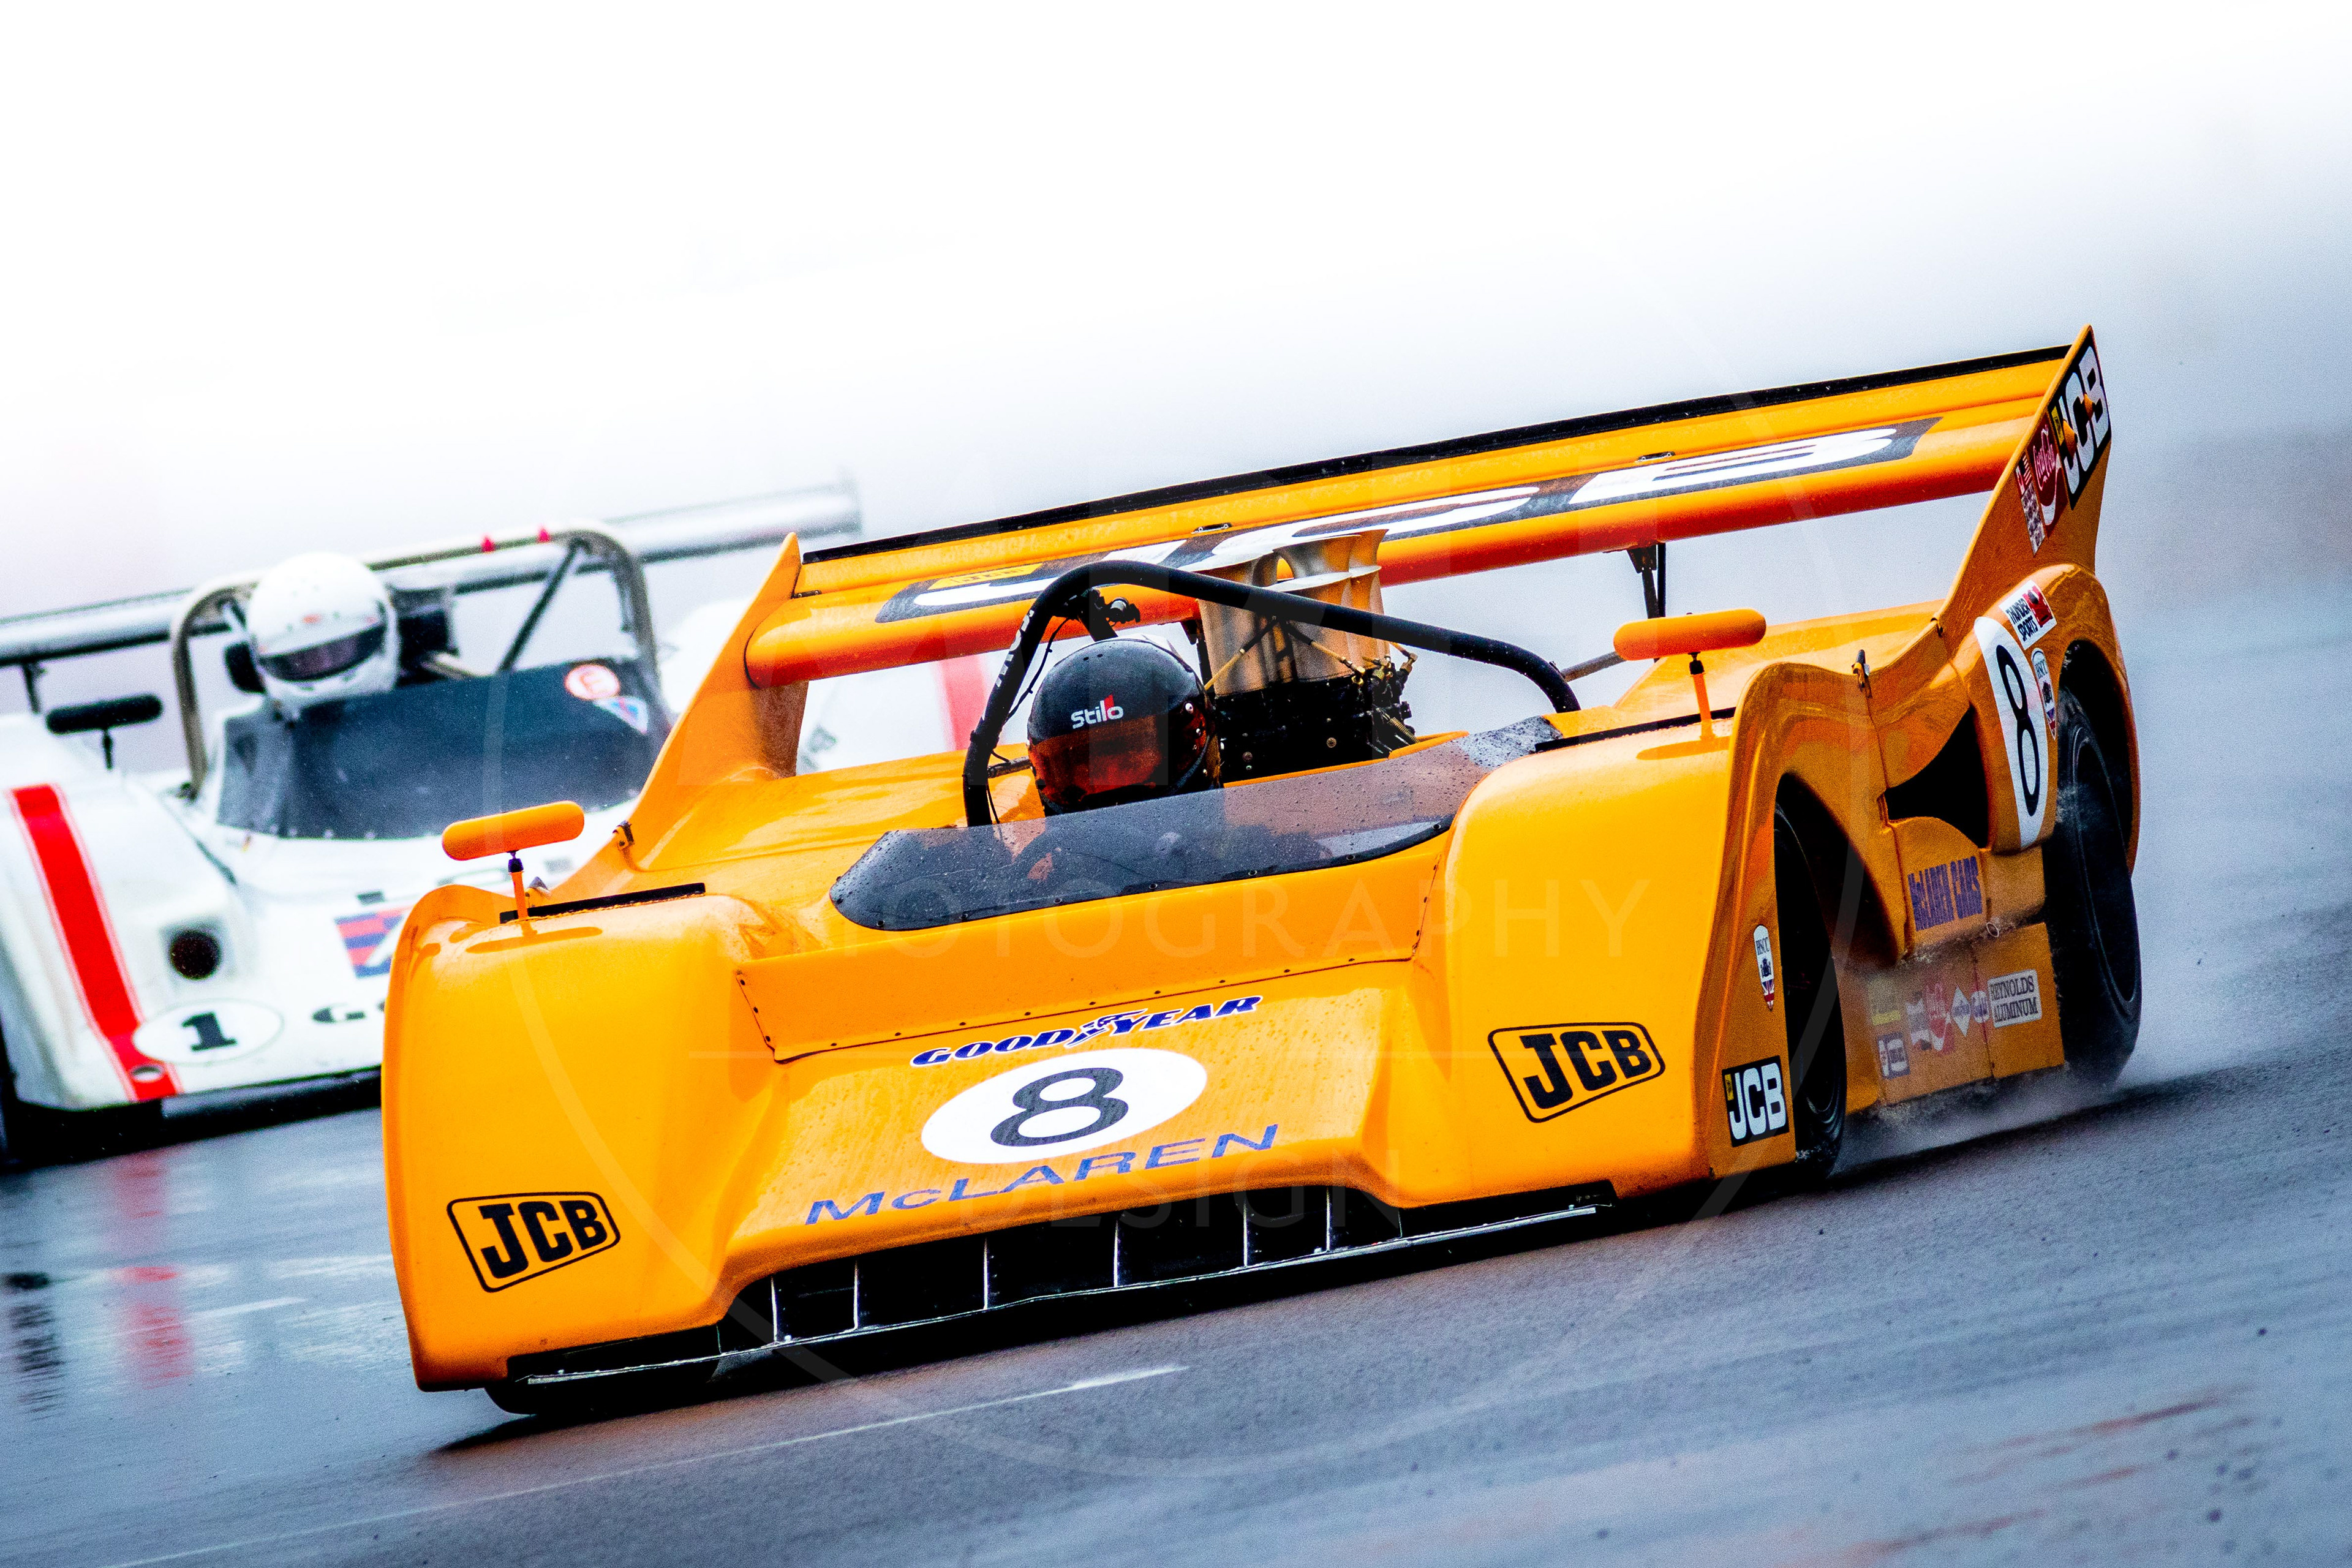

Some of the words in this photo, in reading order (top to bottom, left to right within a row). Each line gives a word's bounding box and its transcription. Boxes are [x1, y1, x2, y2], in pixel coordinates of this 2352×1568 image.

[2059, 346, 2109, 494] JCB
[913, 428, 1899, 606] JCB
[2005, 597, 2032, 625] THUNDER
[2017, 615, 2038, 642] SPORTS
[1070, 694, 1124, 729] Stilo
[1996, 644, 2040, 816] 8
[1991, 975, 2035, 1001] REYNOLDS
[1994, 997, 2039, 1022] ALUMINUM
[180, 1011, 238, 1052] 1
[911, 995, 1263, 1067] GOODYEAR
[1519, 1030, 1653, 1109] JCB
[990, 1068, 1129, 1147] 8
[1728, 1062, 1787, 1140] JCB
[805, 1123, 1280, 1226] McLAREN
[477, 1199, 608, 1279] JCB
